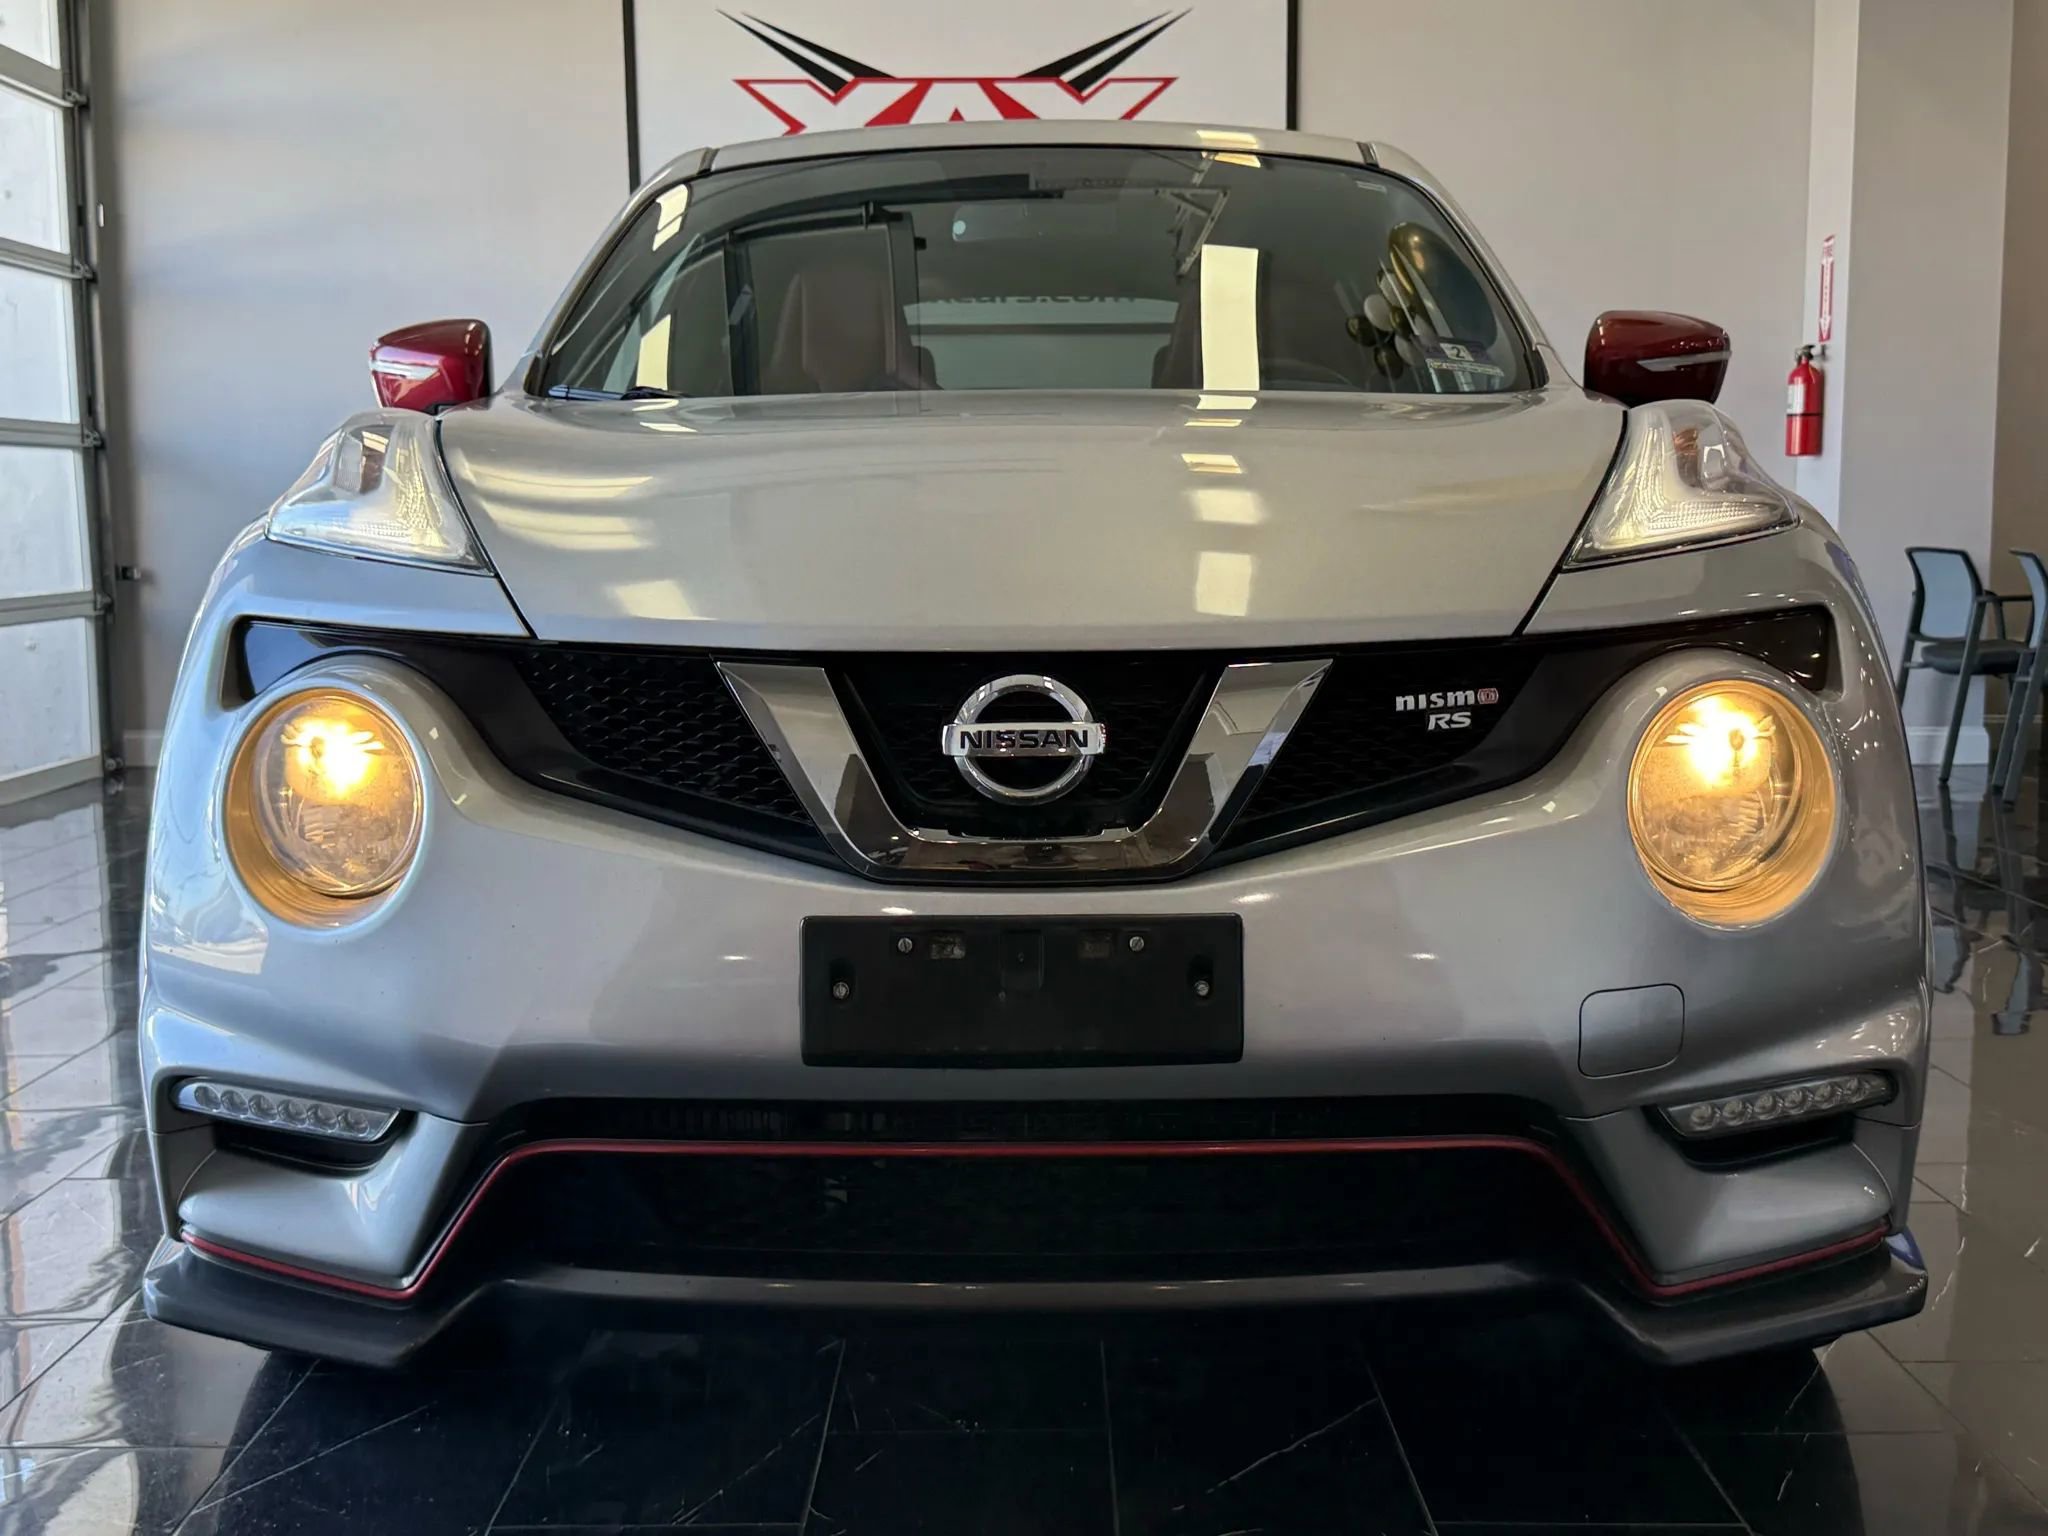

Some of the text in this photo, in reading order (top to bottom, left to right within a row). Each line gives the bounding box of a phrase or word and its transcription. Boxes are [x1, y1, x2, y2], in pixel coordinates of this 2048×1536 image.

[1395, 687, 1499, 712] nismo
[1428, 711, 1472, 730] RS
[960, 729, 1088, 749] NISSAN
